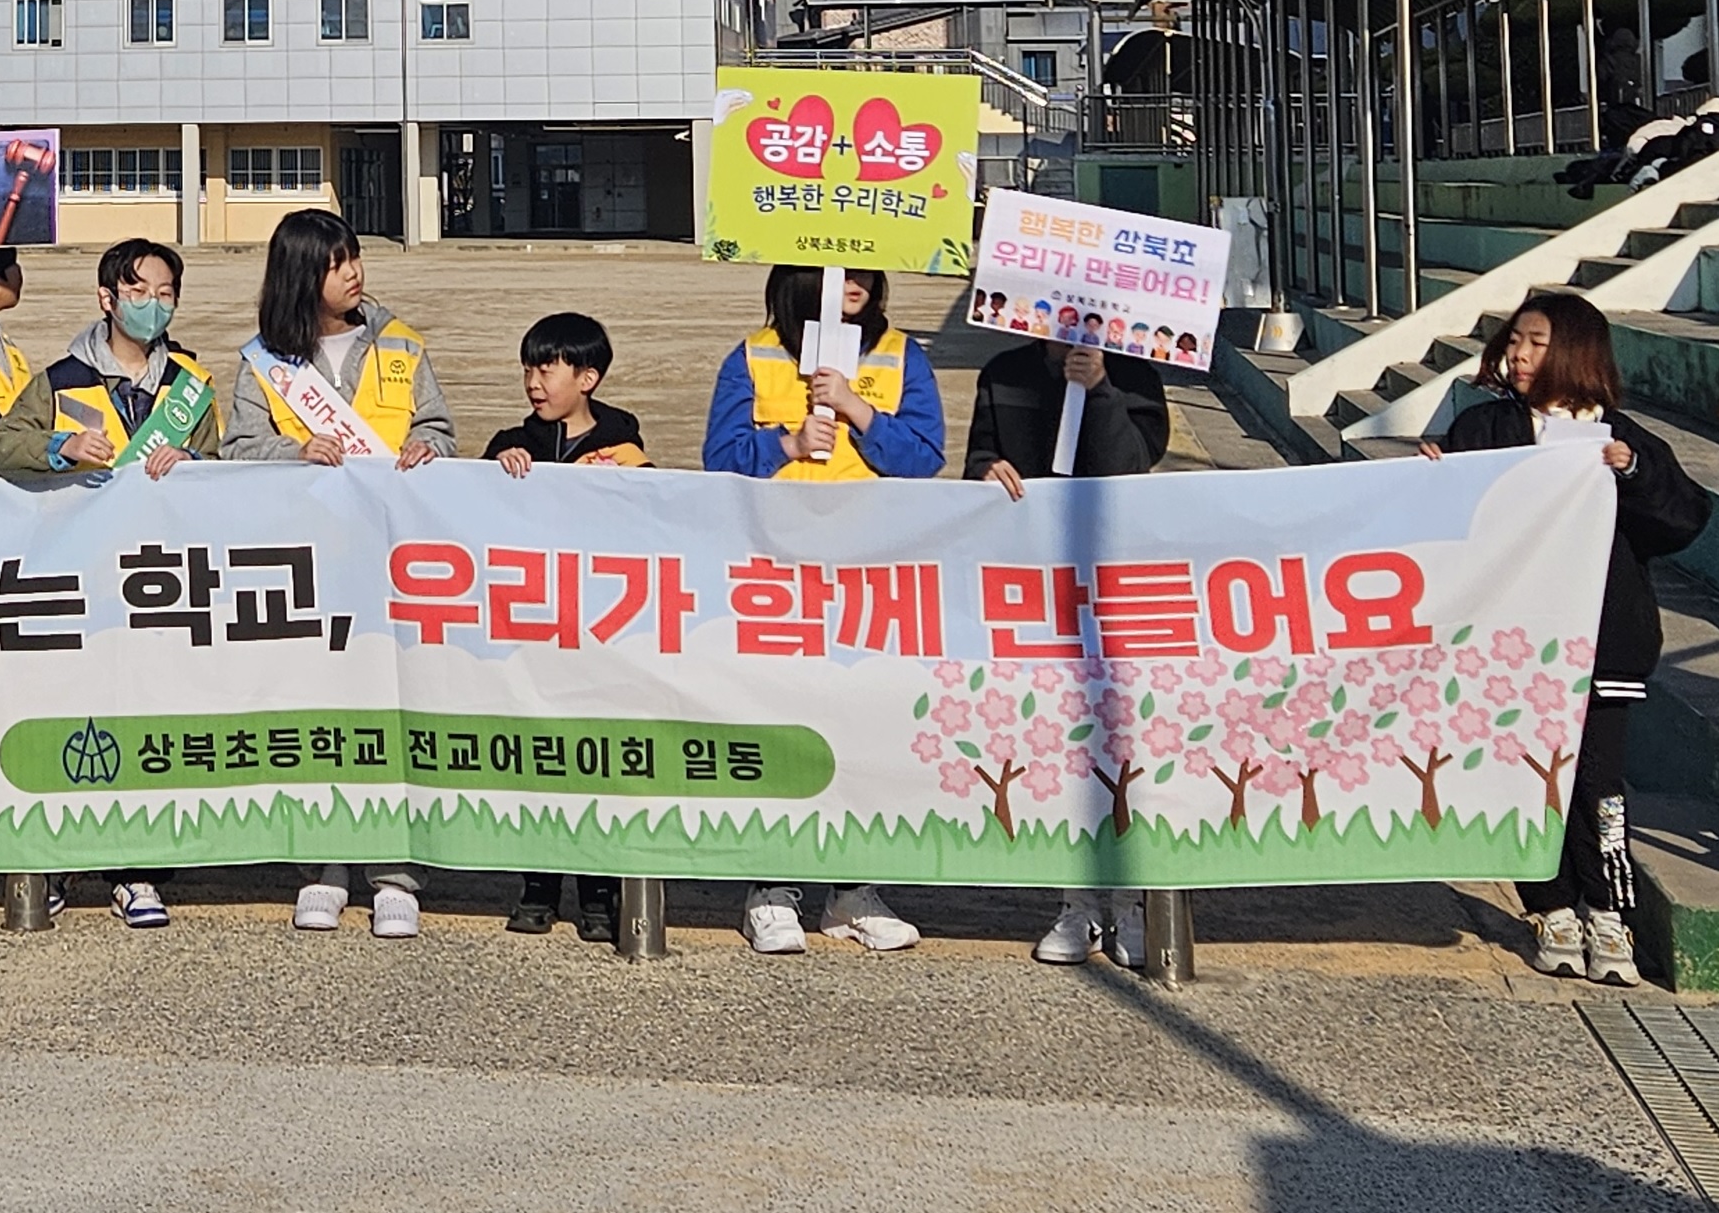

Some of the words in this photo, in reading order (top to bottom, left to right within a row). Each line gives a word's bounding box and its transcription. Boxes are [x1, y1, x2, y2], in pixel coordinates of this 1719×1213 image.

[759, 123, 828, 164] 공감
[860, 130, 931, 172] 소통
[753, 184, 825, 213] 행복한
[831, 185, 928, 219] 우리학교
[795, 236, 876, 254] 상북초등학교
[1018, 209, 1106, 248] 행복한
[1113, 229, 1197, 267] 상북초
[991, 241, 1078, 278] 우리가
[1084, 257, 1211, 305] 만들어요!
[120, 544, 353, 651] 학교,
[387, 541, 696, 653] 우리가
[728, 556, 943, 658] 함께
[979, 552, 1432, 658] 만들어요
[137, 726, 388, 774] 상북초등학교
[408, 729, 657, 780] 전교어린이회
[682, 738, 765, 782] 일동
